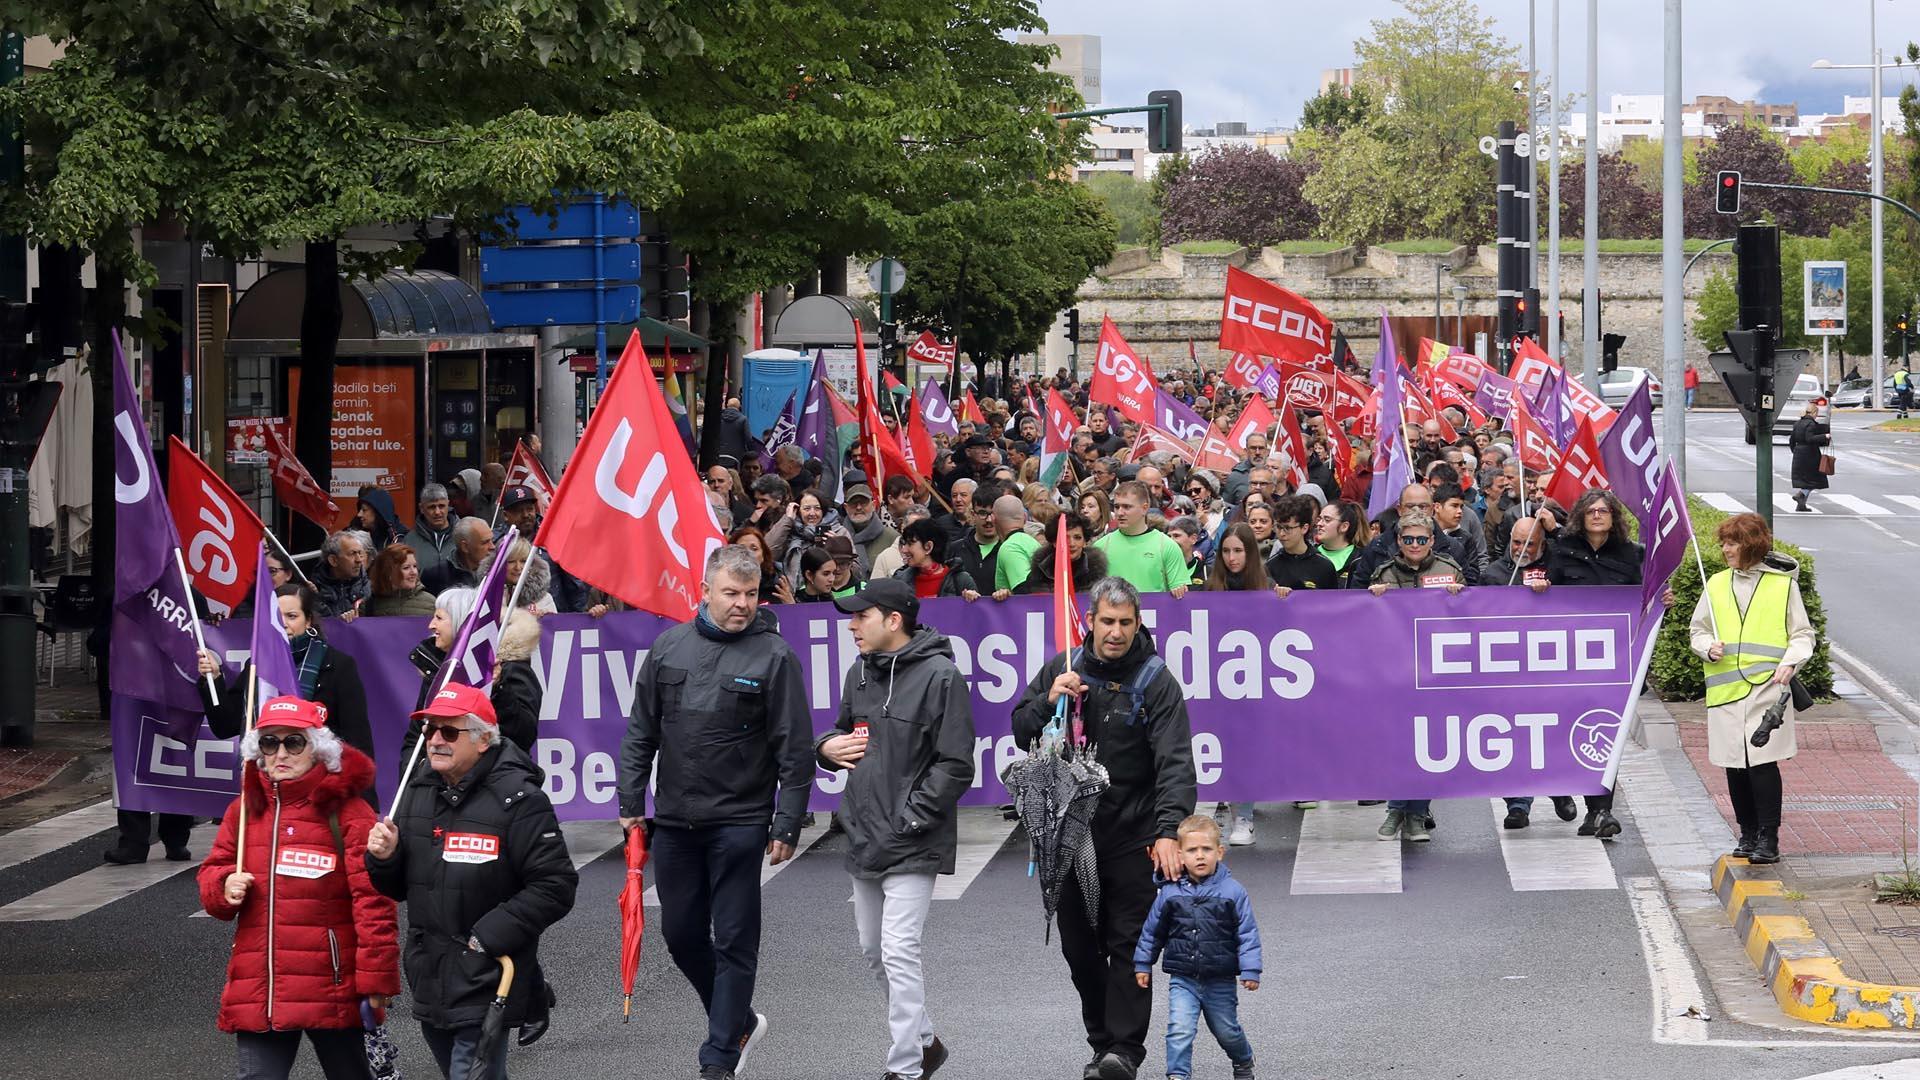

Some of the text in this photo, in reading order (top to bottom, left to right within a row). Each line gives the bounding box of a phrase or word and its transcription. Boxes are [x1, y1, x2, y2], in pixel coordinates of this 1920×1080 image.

[1227, 295, 1326, 348] CCOO
[1098, 342, 1154, 395] UGT
[1234, 353, 1263, 384] UG
[373, 382, 397, 394] beti
[1291, 377, 1323, 399] UGT
[333, 396, 372, 408] ermin.
[446, 402, 474, 413] 8 10
[330, 426, 383, 438] agabea
[444, 423, 473, 434] 15 21
[331, 440, 406, 451] behar luke.
[1424, 575, 1454, 584] CCOO
[1431, 628, 1616, 674] CCOO
[1414, 712, 1559, 773] UGT
[448, 836, 496, 852] CCOO
[281, 850, 333, 868] CCOO
